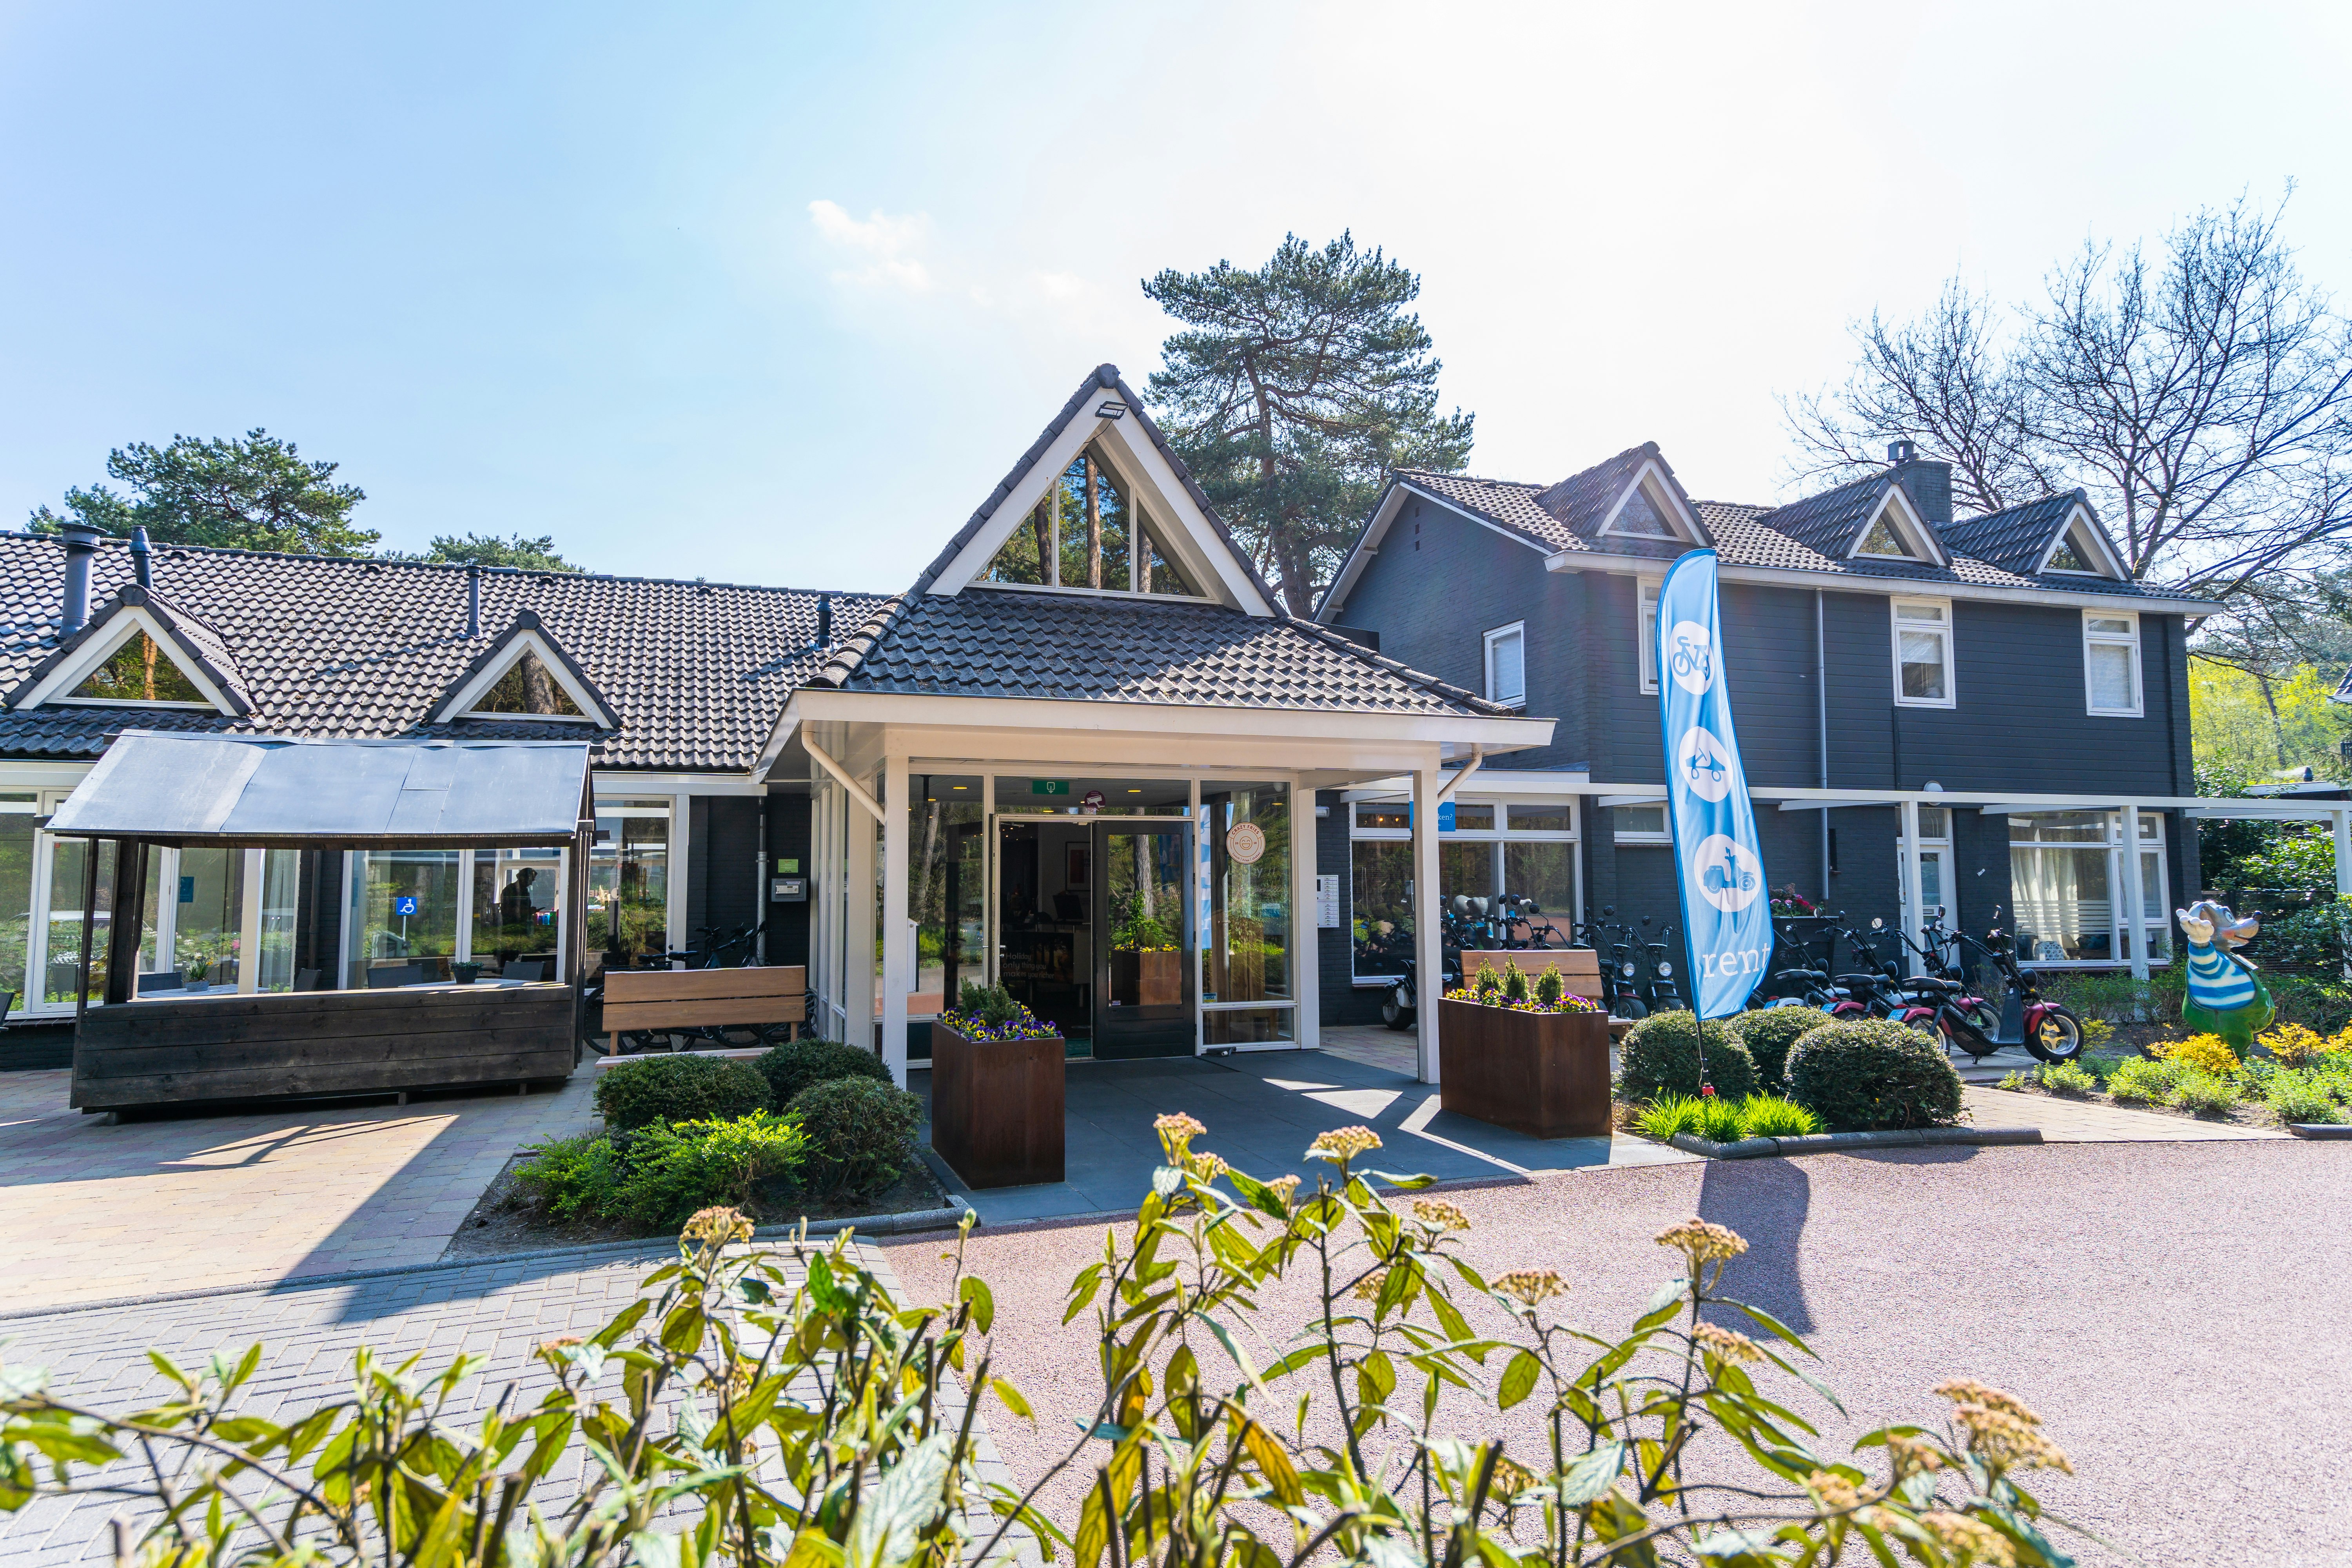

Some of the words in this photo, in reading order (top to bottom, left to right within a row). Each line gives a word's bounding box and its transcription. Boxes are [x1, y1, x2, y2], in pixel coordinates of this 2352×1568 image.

[1232, 824, 1246, 835] CRAZY
[1247, 825, 1259, 834] FRIES
[1005, 953, 1031, 962] Holiday
[1702, 943, 1771, 978] rent
[1003, 961, 1020, 969] only
[1022, 961, 1035, 970] thing
